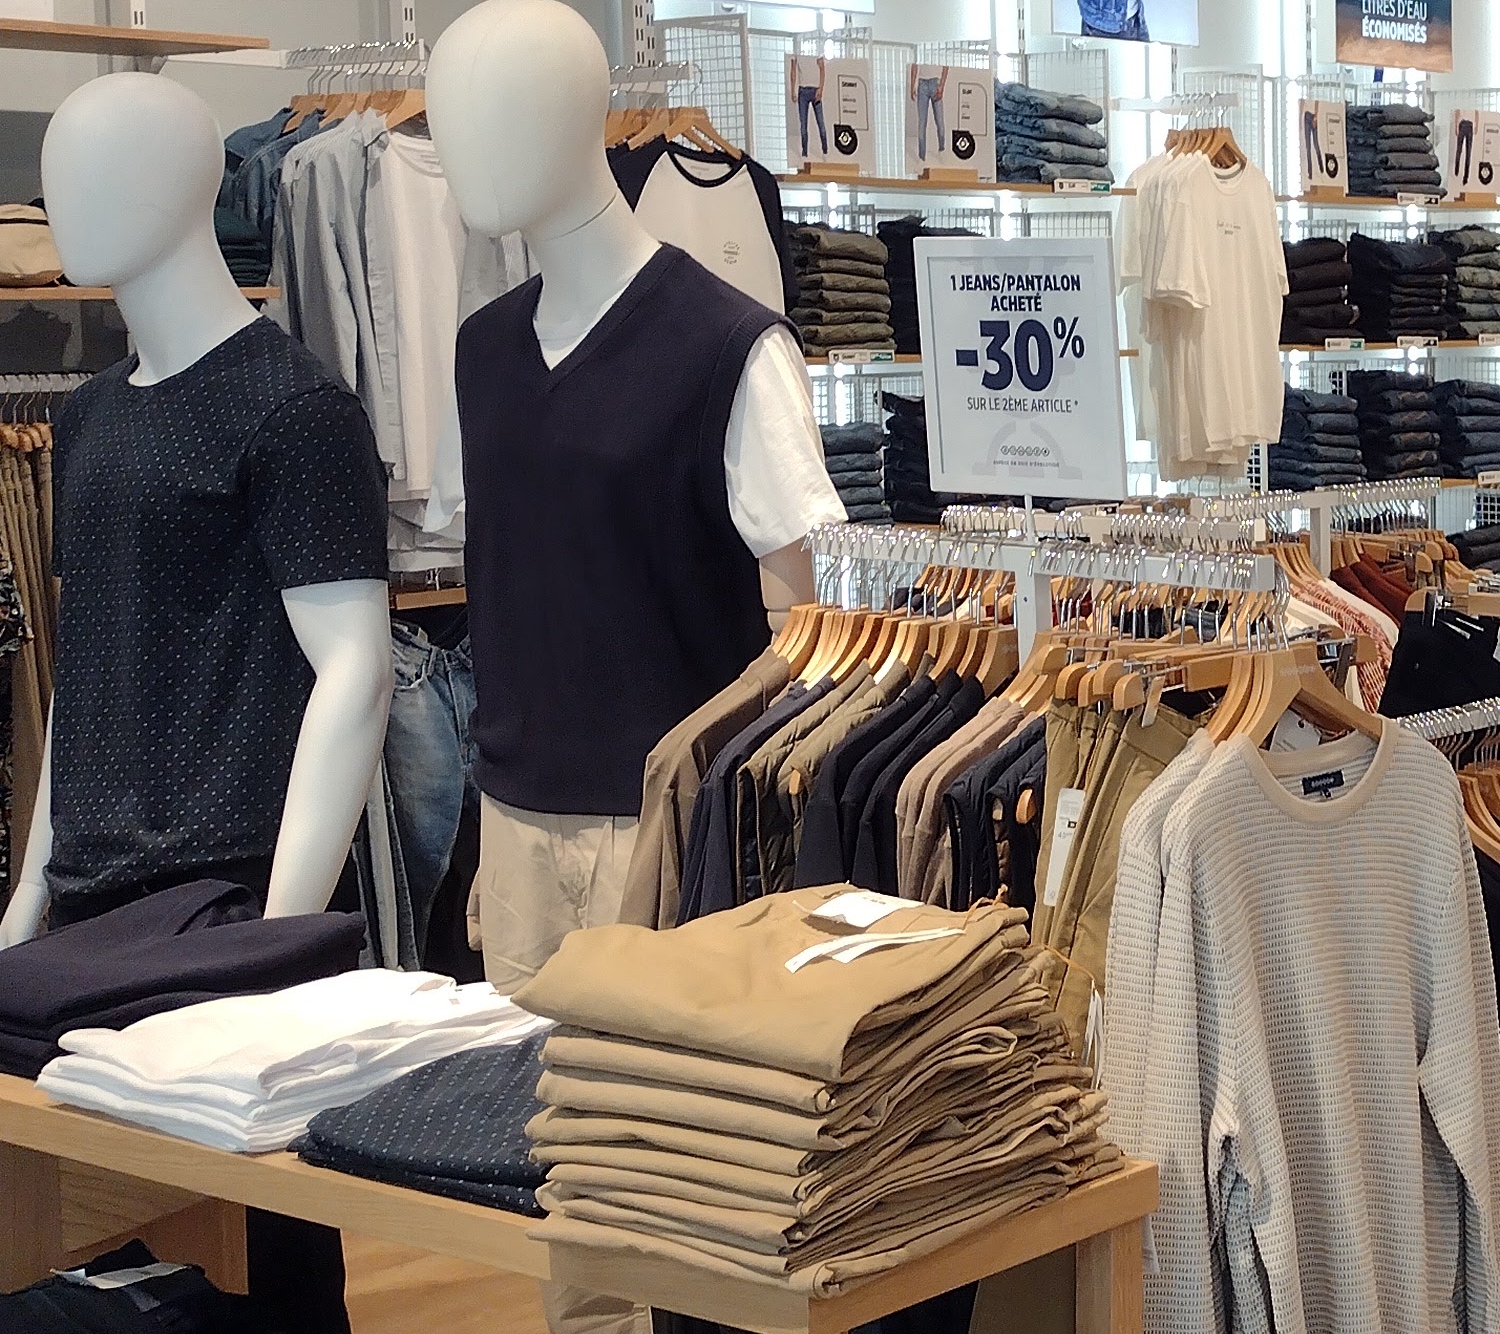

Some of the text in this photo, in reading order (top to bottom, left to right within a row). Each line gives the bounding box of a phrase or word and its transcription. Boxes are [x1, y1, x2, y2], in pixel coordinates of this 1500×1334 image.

[1362, 15, 1428, 44] ÉCONOMISÉS
[951, 273, 1081, 293] 1 JEANS/PANTALON
[991, 293, 1043, 312] ACHETÉ
[955, 316, 1085, 392] -30%
[967, 395, 1073, 414] SUR LE 2ÈME ARTICLE
